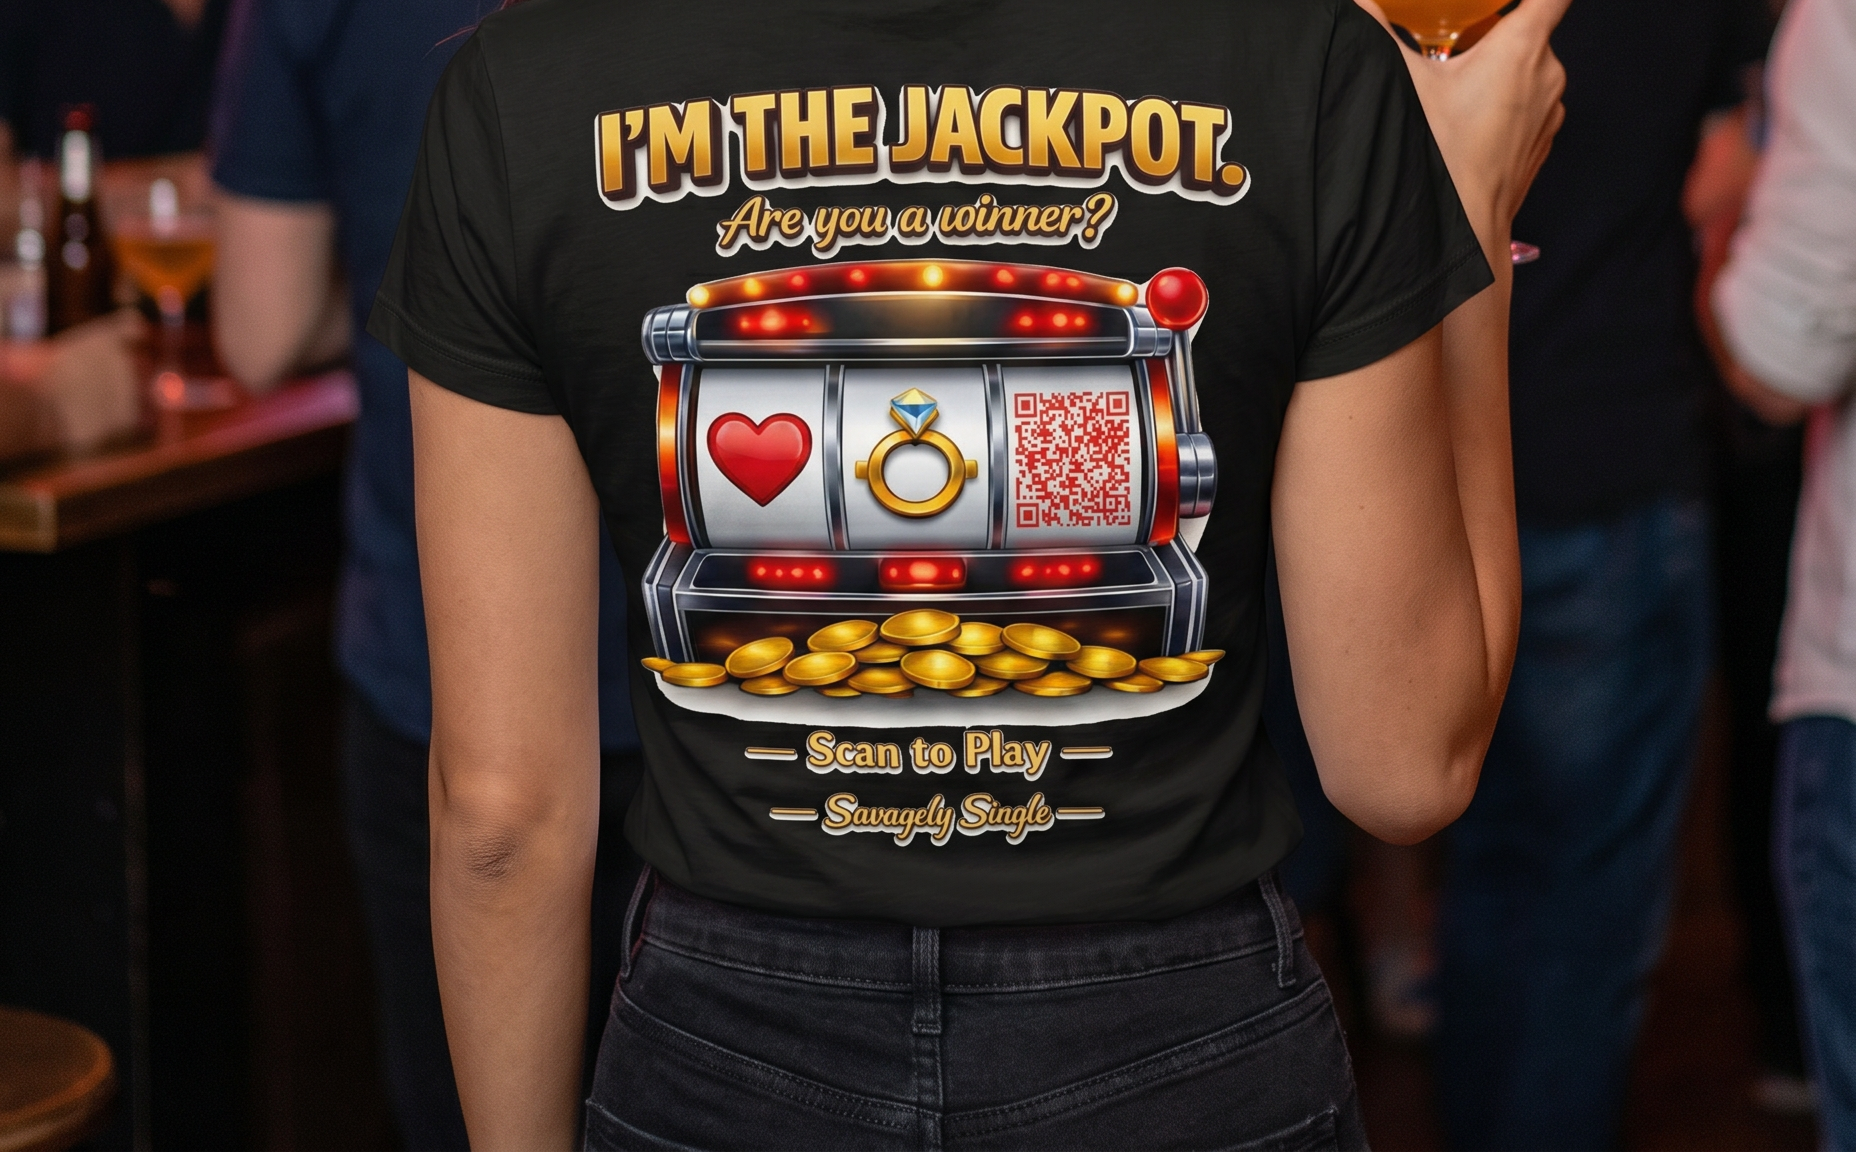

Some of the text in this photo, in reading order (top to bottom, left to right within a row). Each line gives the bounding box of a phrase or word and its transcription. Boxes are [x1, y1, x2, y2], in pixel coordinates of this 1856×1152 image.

[597, 84, 1250, 204] I'M THE JACKPOT.
[718, 192, 1116, 252] Are you a winner?
[807, 729, 1052, 780] Scan to Play
[822, 792, 1055, 845] Savagely Single
